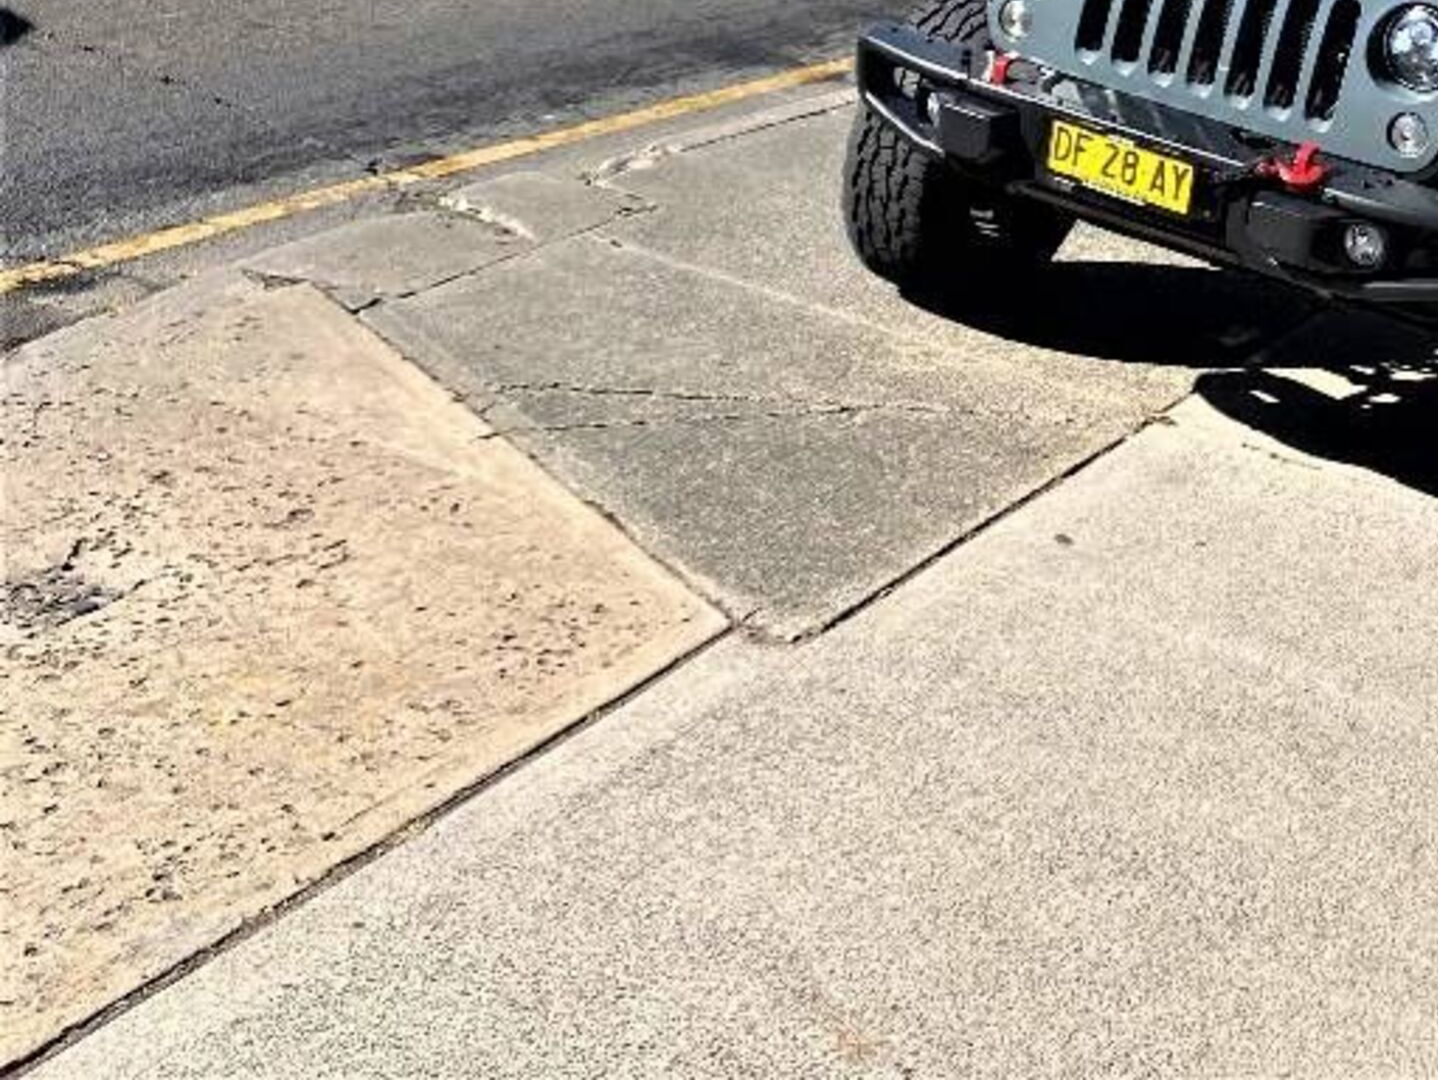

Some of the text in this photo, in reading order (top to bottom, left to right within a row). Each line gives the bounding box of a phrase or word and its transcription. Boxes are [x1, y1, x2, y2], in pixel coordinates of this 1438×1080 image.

[1053, 125, 1095, 167] DF
[1101, 142, 1141, 186] 28
[1150, 159, 1192, 201] AY
